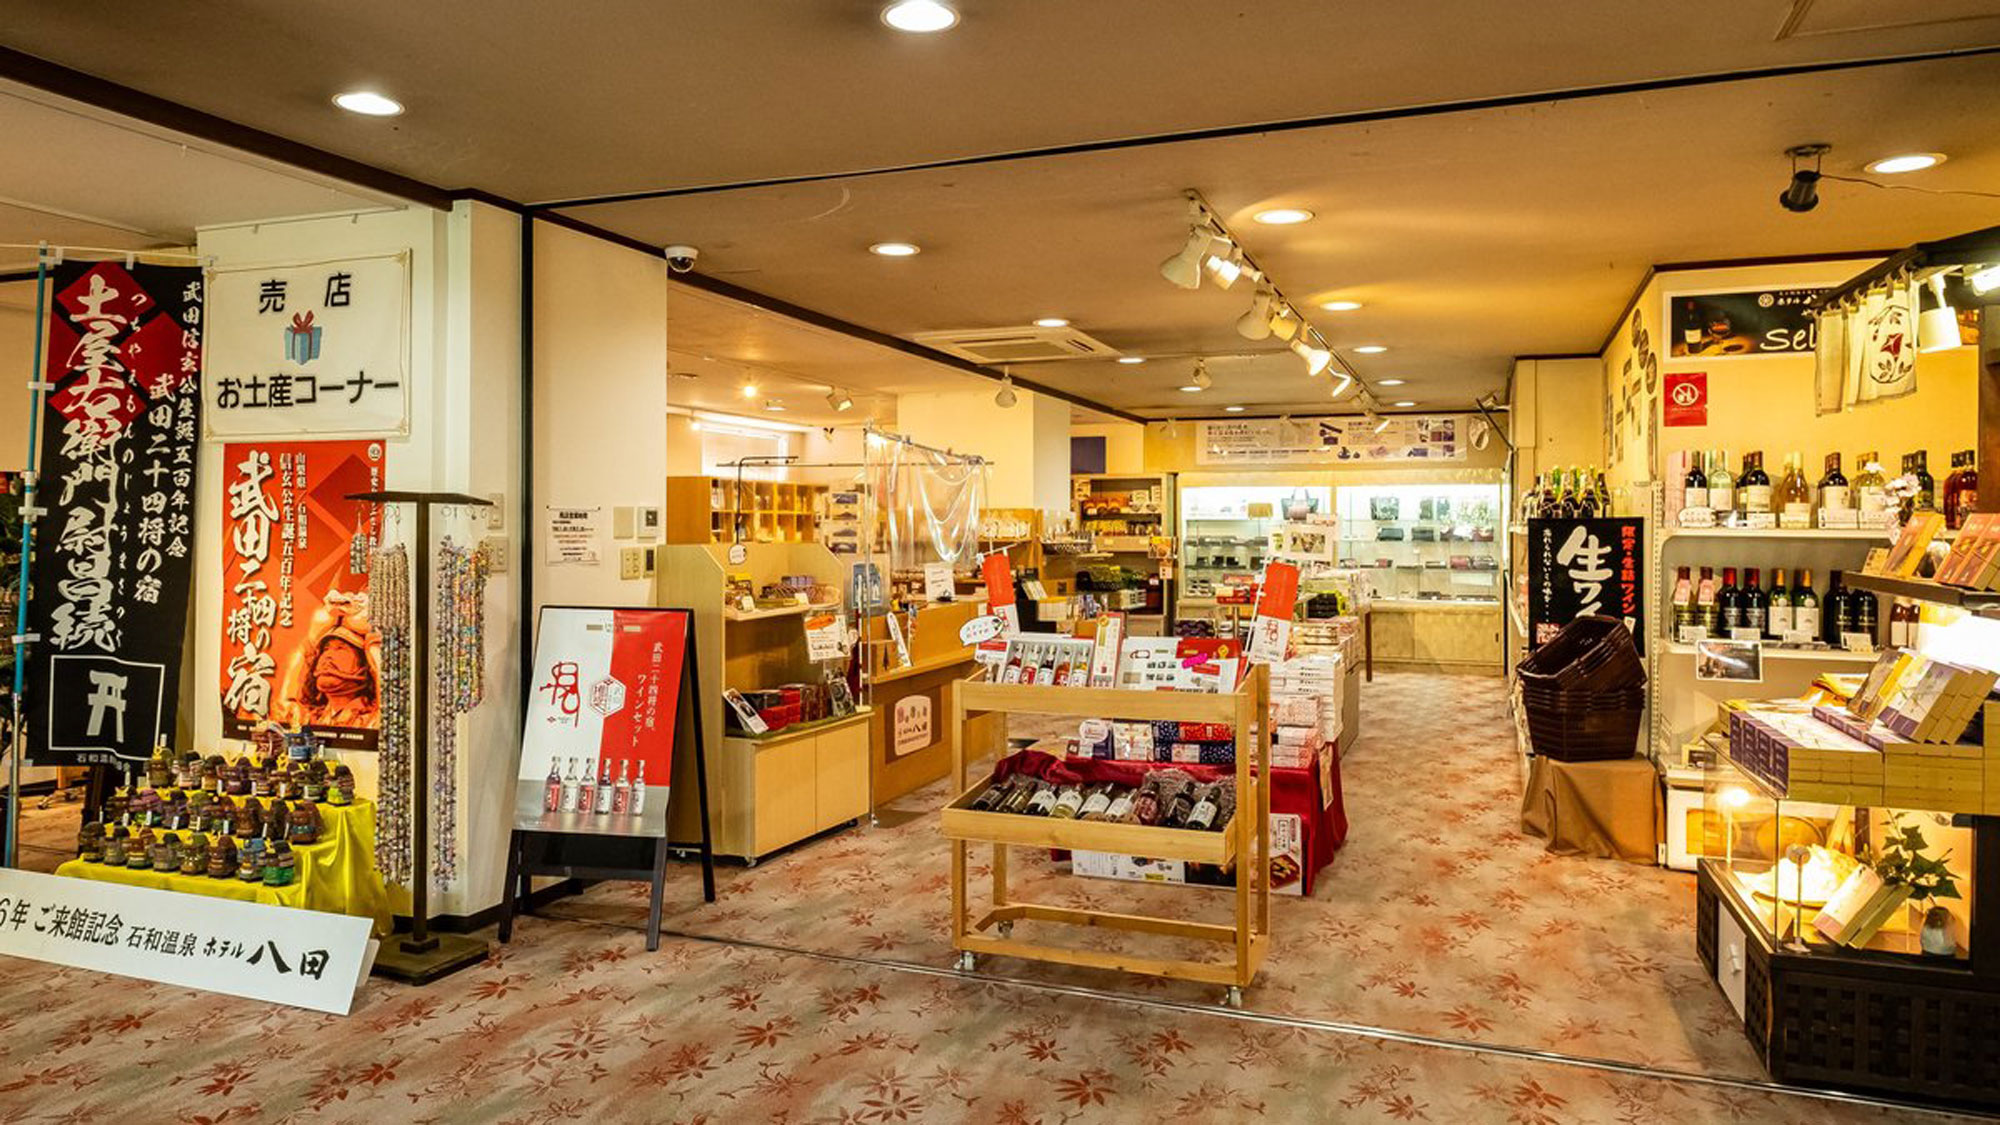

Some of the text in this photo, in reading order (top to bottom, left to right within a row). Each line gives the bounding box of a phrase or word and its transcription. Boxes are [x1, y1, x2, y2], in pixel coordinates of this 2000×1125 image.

[217, 370, 399, 409] お土産コーナー
[133, 373, 176, 604] 武田二十四将の宿
[34, 904, 124, 946] ご来館記念
[126, 925, 196, 958] 石和温泉
